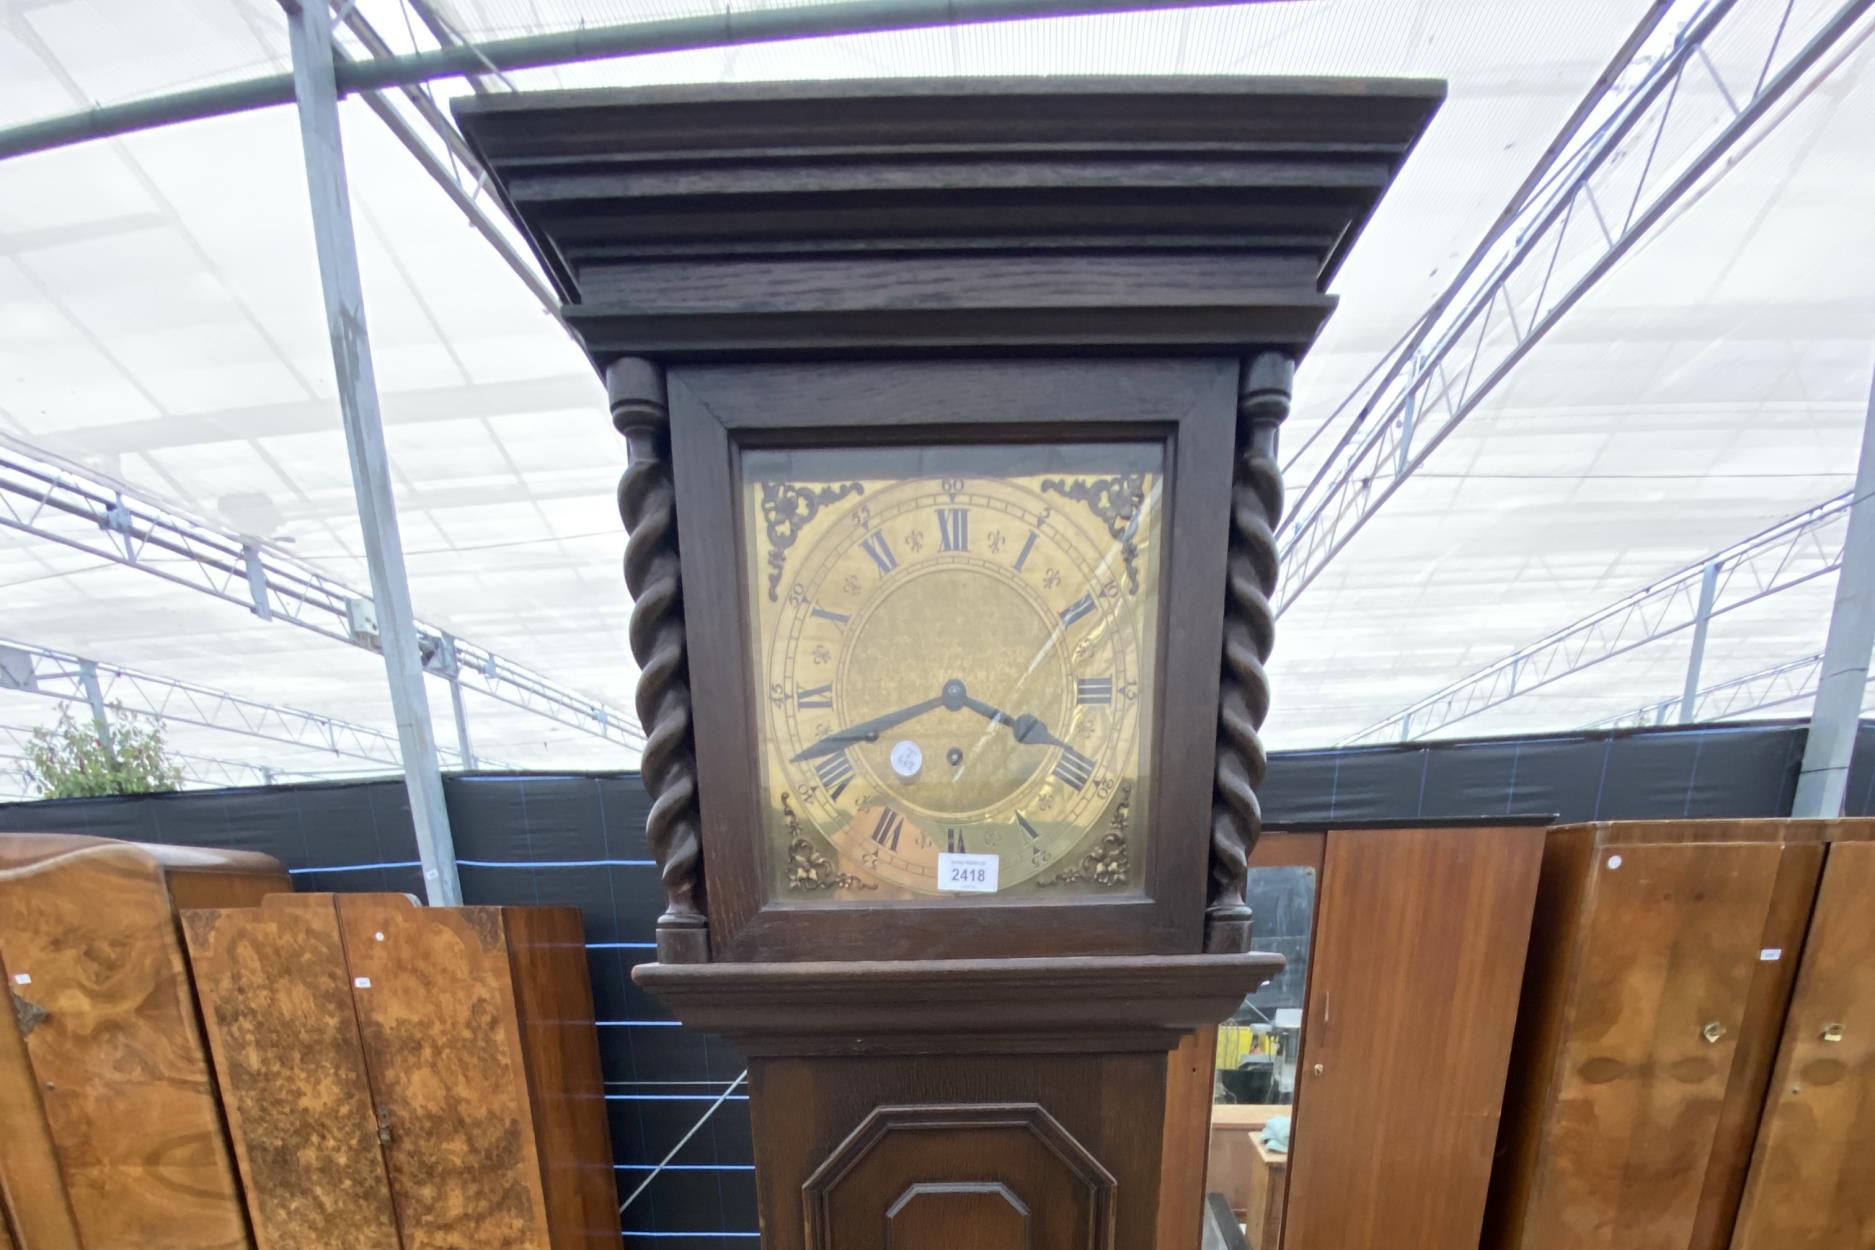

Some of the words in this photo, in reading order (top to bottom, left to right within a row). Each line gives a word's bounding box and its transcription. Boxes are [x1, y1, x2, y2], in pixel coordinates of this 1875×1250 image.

[941, 479, 965, 495] 60
[935, 507, 971, 553] XII
[859, 527, 899, 578] XI
[1012, 528, 1041, 574] I
[1104, 580, 1120, 598] 10
[810, 598, 852, 634] X
[1059, 591, 1098, 629] II
[796, 681, 834, 712] IX
[1076, 674, 1113, 705] III
[814, 750, 857, 801] VIII
[1051, 748, 1099, 793] IIII
[871, 806, 905, 854] VII
[951, 868, 985, 882] 2418
